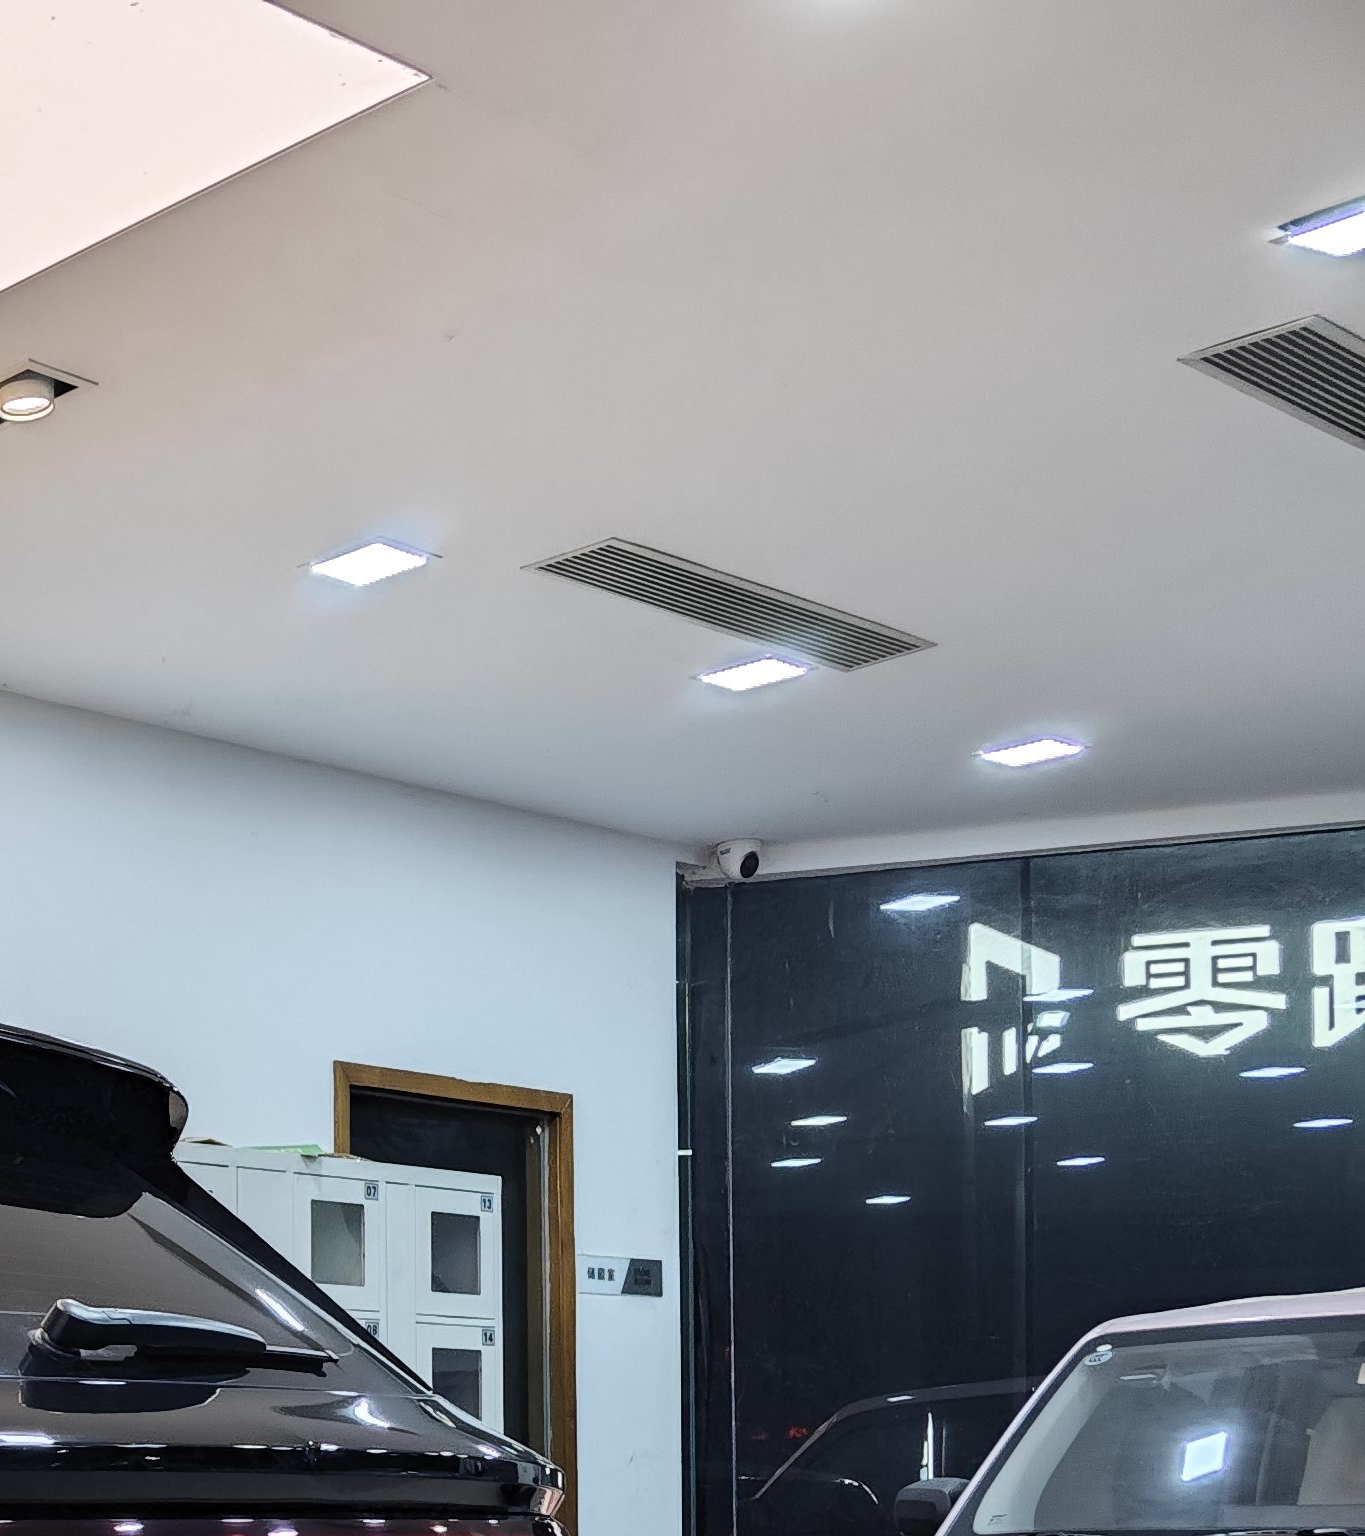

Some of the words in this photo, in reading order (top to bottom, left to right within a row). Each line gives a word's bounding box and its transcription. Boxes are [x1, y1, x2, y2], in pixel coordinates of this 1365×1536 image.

[365, 1185, 377, 1198] 07
[482, 1197, 492, 1210] 13
[483, 1331, 494, 1343] 14
